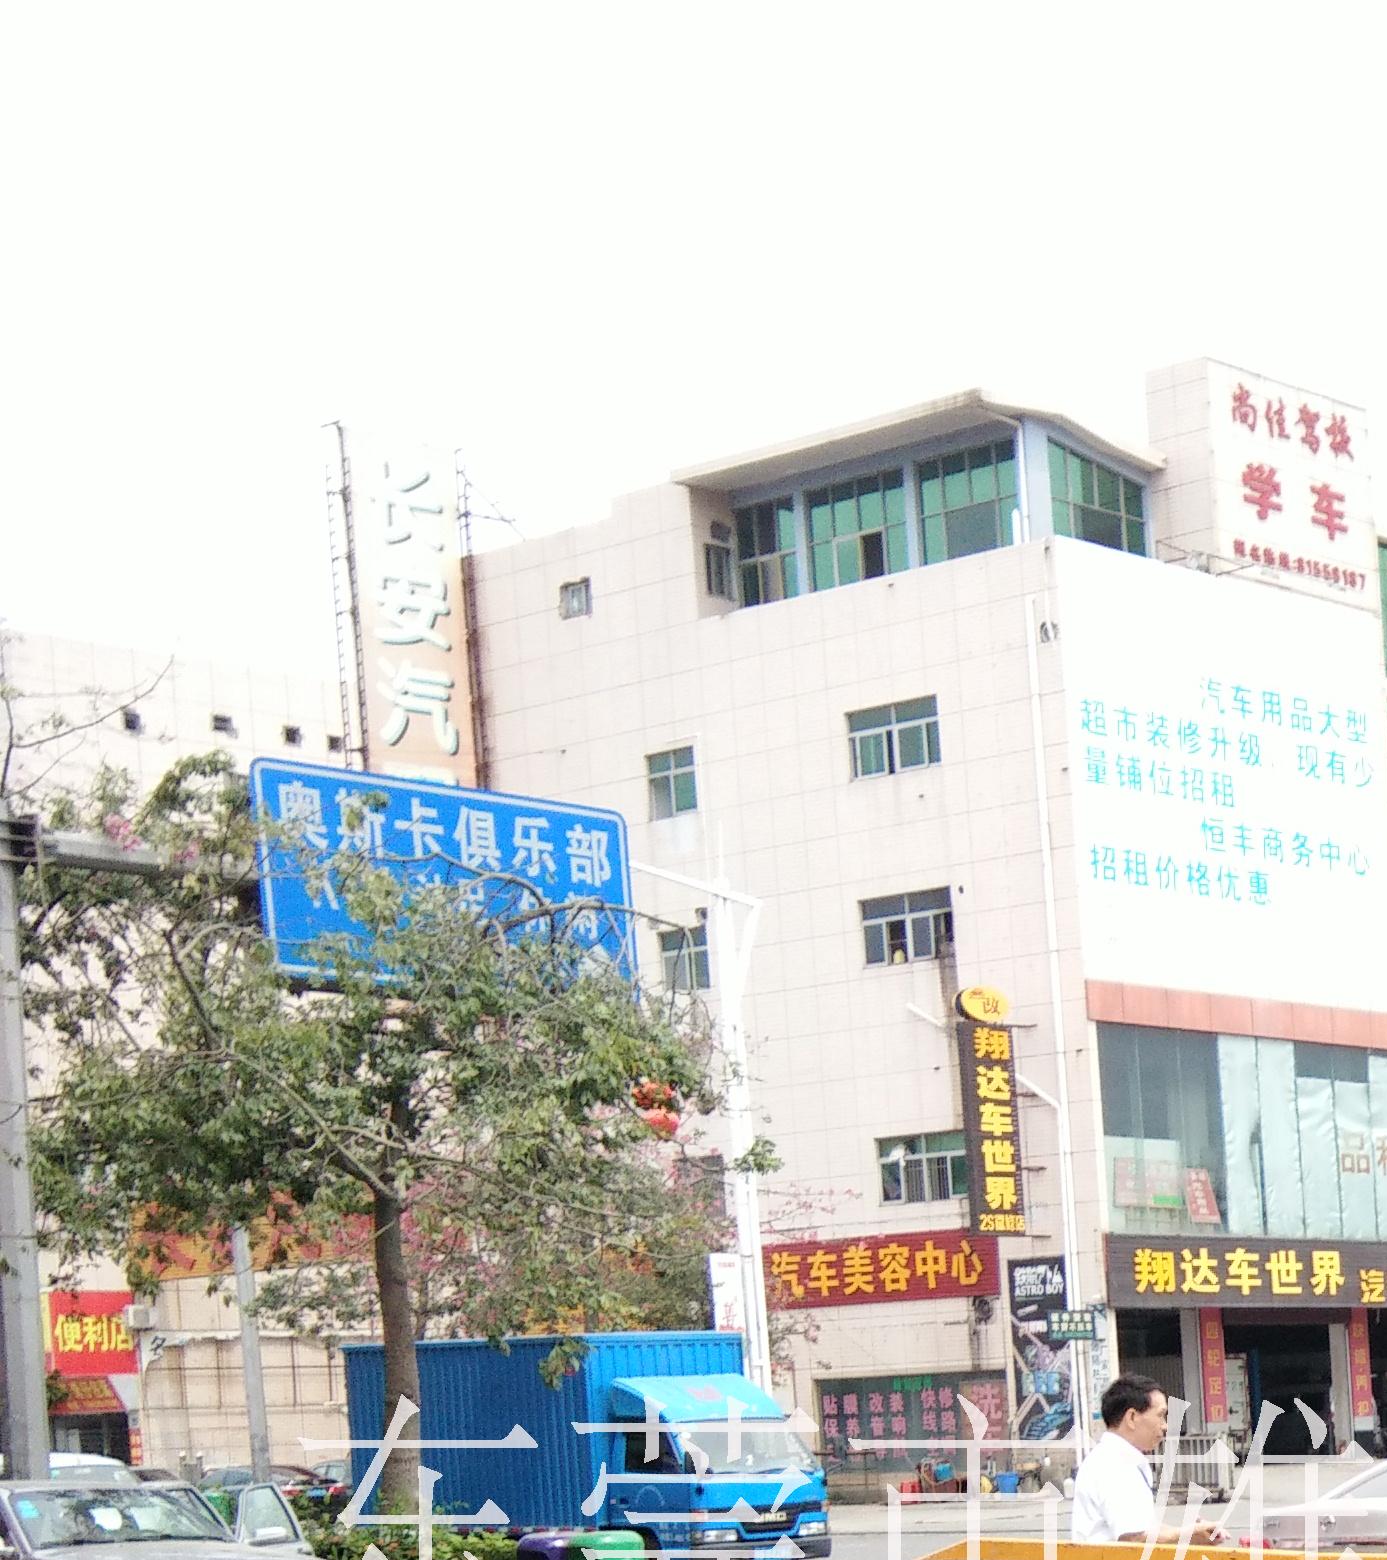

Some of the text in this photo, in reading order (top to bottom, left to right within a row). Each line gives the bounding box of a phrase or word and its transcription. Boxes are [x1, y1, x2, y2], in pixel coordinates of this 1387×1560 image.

[1232, 382, 1354, 461] 尚佳驾校
[1241, 463, 1348, 541] 学车
[1200, 677, 1368, 744] 汽车用品大型
[1085, 746, 1234, 808] 量铺位招租
[278, 781, 612, 888] 奥斯卡俱乐部
[1201, 816, 1370, 876] 恒丰商务中心
[1090, 843, 1271, 905] 招租价格优惠
[973, 1027, 1018, 1210] 翔达车世界
[771, 1240, 983, 1297] 汽车美容中心
[1134, 1248, 1345, 1295] 翔达车世界
[55, 1315, 134, 1353] 便利店
